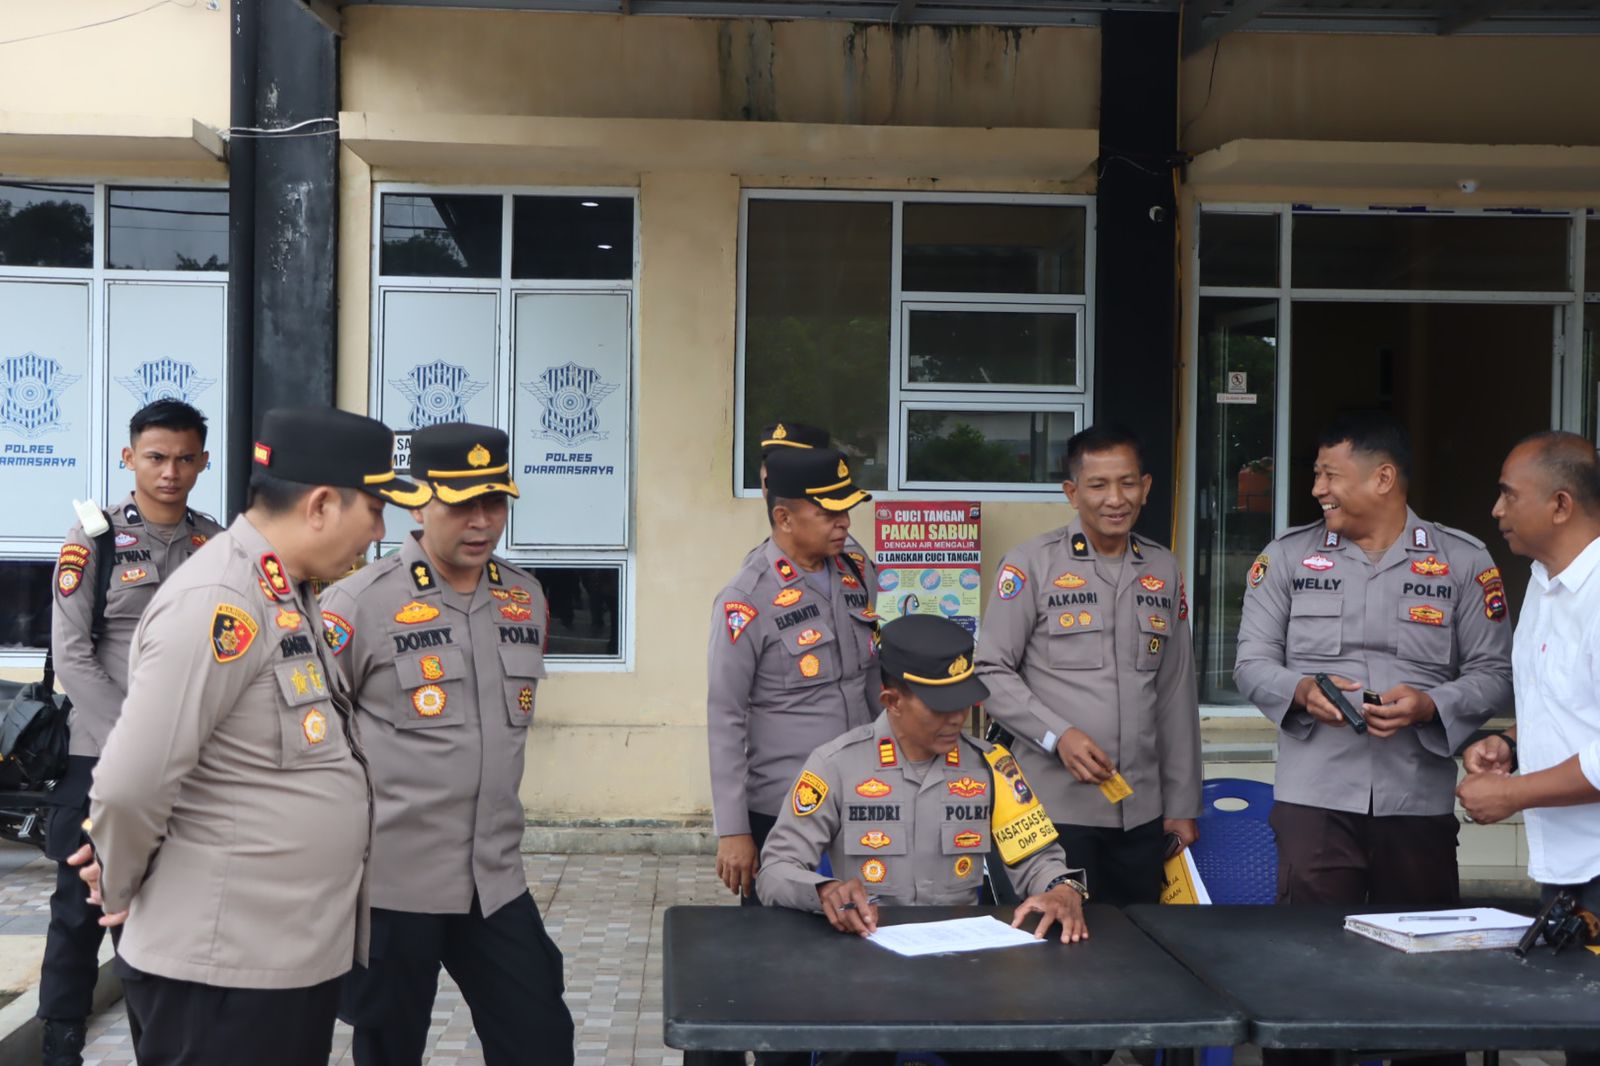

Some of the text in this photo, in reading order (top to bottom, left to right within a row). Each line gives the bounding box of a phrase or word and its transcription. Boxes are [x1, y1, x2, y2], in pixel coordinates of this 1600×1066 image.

[5, 444, 55, 455] POLRES
[545, 453, 593, 463] POLRES
[524, 465, 614, 475] DHARMASRAYA
[895, 510, 965, 522] CUCI TANGAN
[881, 524, 978, 540] PAKAI SABUN
[878, 552, 979, 562] 6 LANGKAH CUCI TANGAN
[1292, 578, 1342, 591] WELLY
[1403, 582, 1452, 599] POLRI
[1047, 592, 1098, 608] ALKADRI
[1136, 594, 1171, 609] POLRI
[393, 627, 453, 653] DONNY
[499, 627, 540, 645] POLRI
[848, 805, 901, 821] HENDRI
[945, 805, 989, 821] POLRI
[995, 813, 1040, 844] KASATGAS
[1018, 831, 1038, 849] OMP
